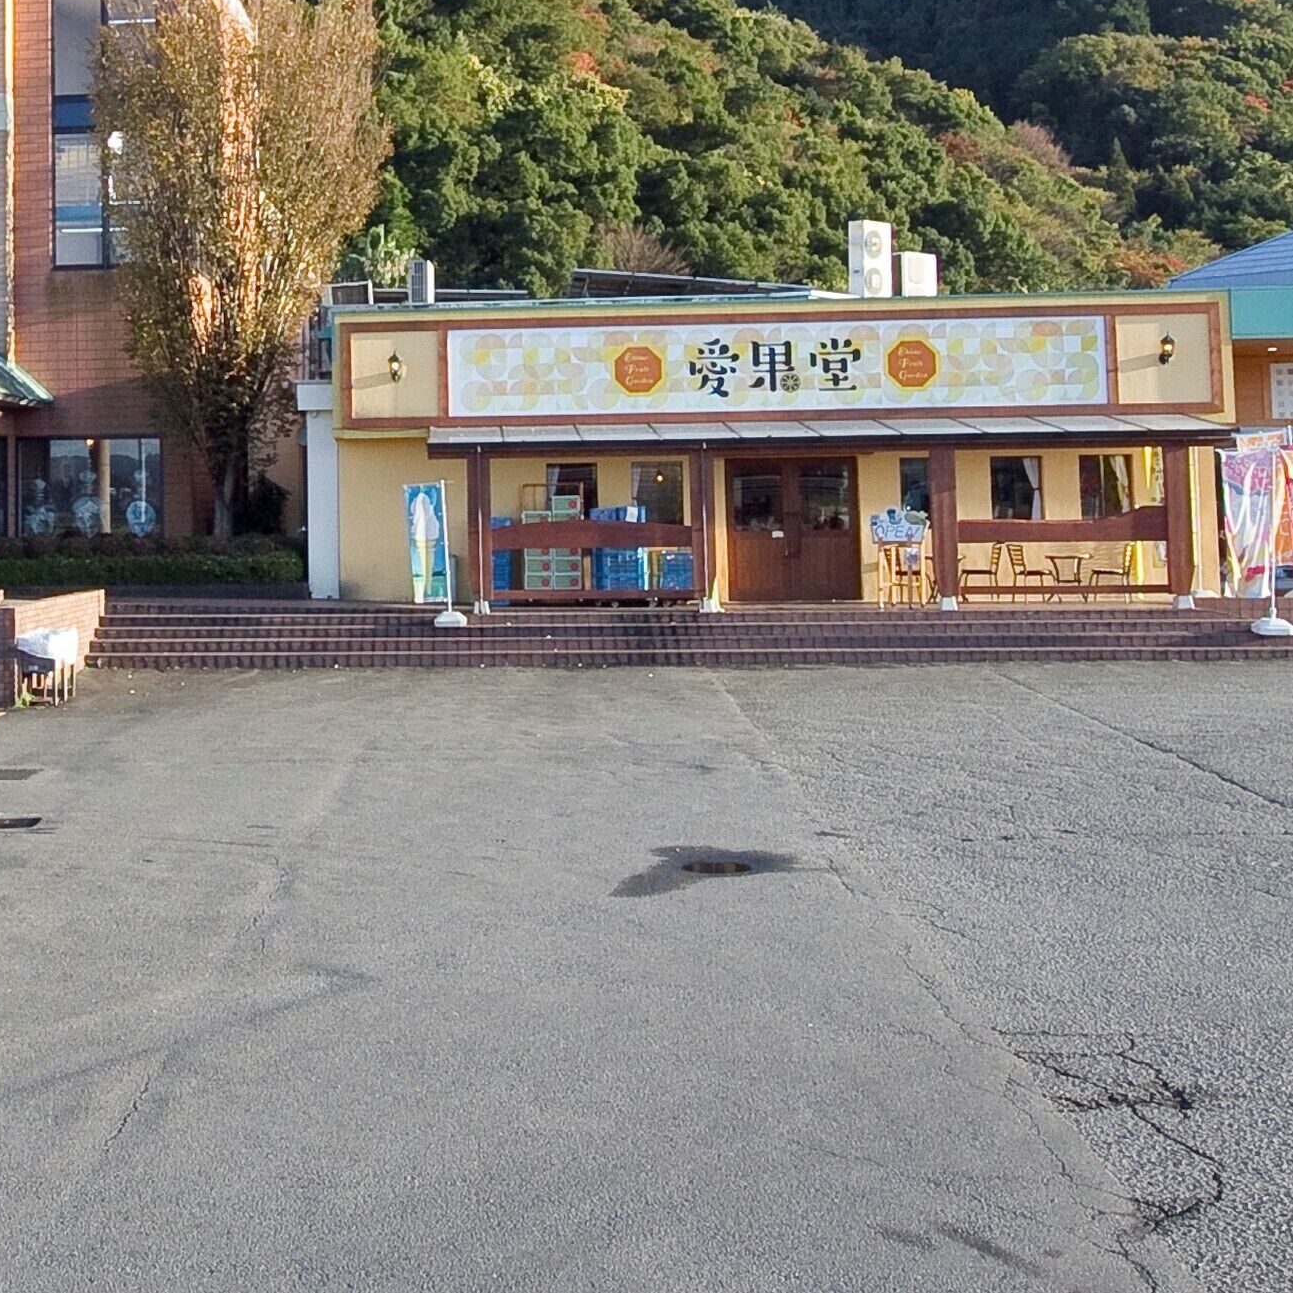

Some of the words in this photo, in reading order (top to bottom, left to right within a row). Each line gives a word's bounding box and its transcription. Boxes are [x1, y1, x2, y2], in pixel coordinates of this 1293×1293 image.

[689, 337, 862, 398] 愛果堂
[875, 524, 920, 539] OPEN
